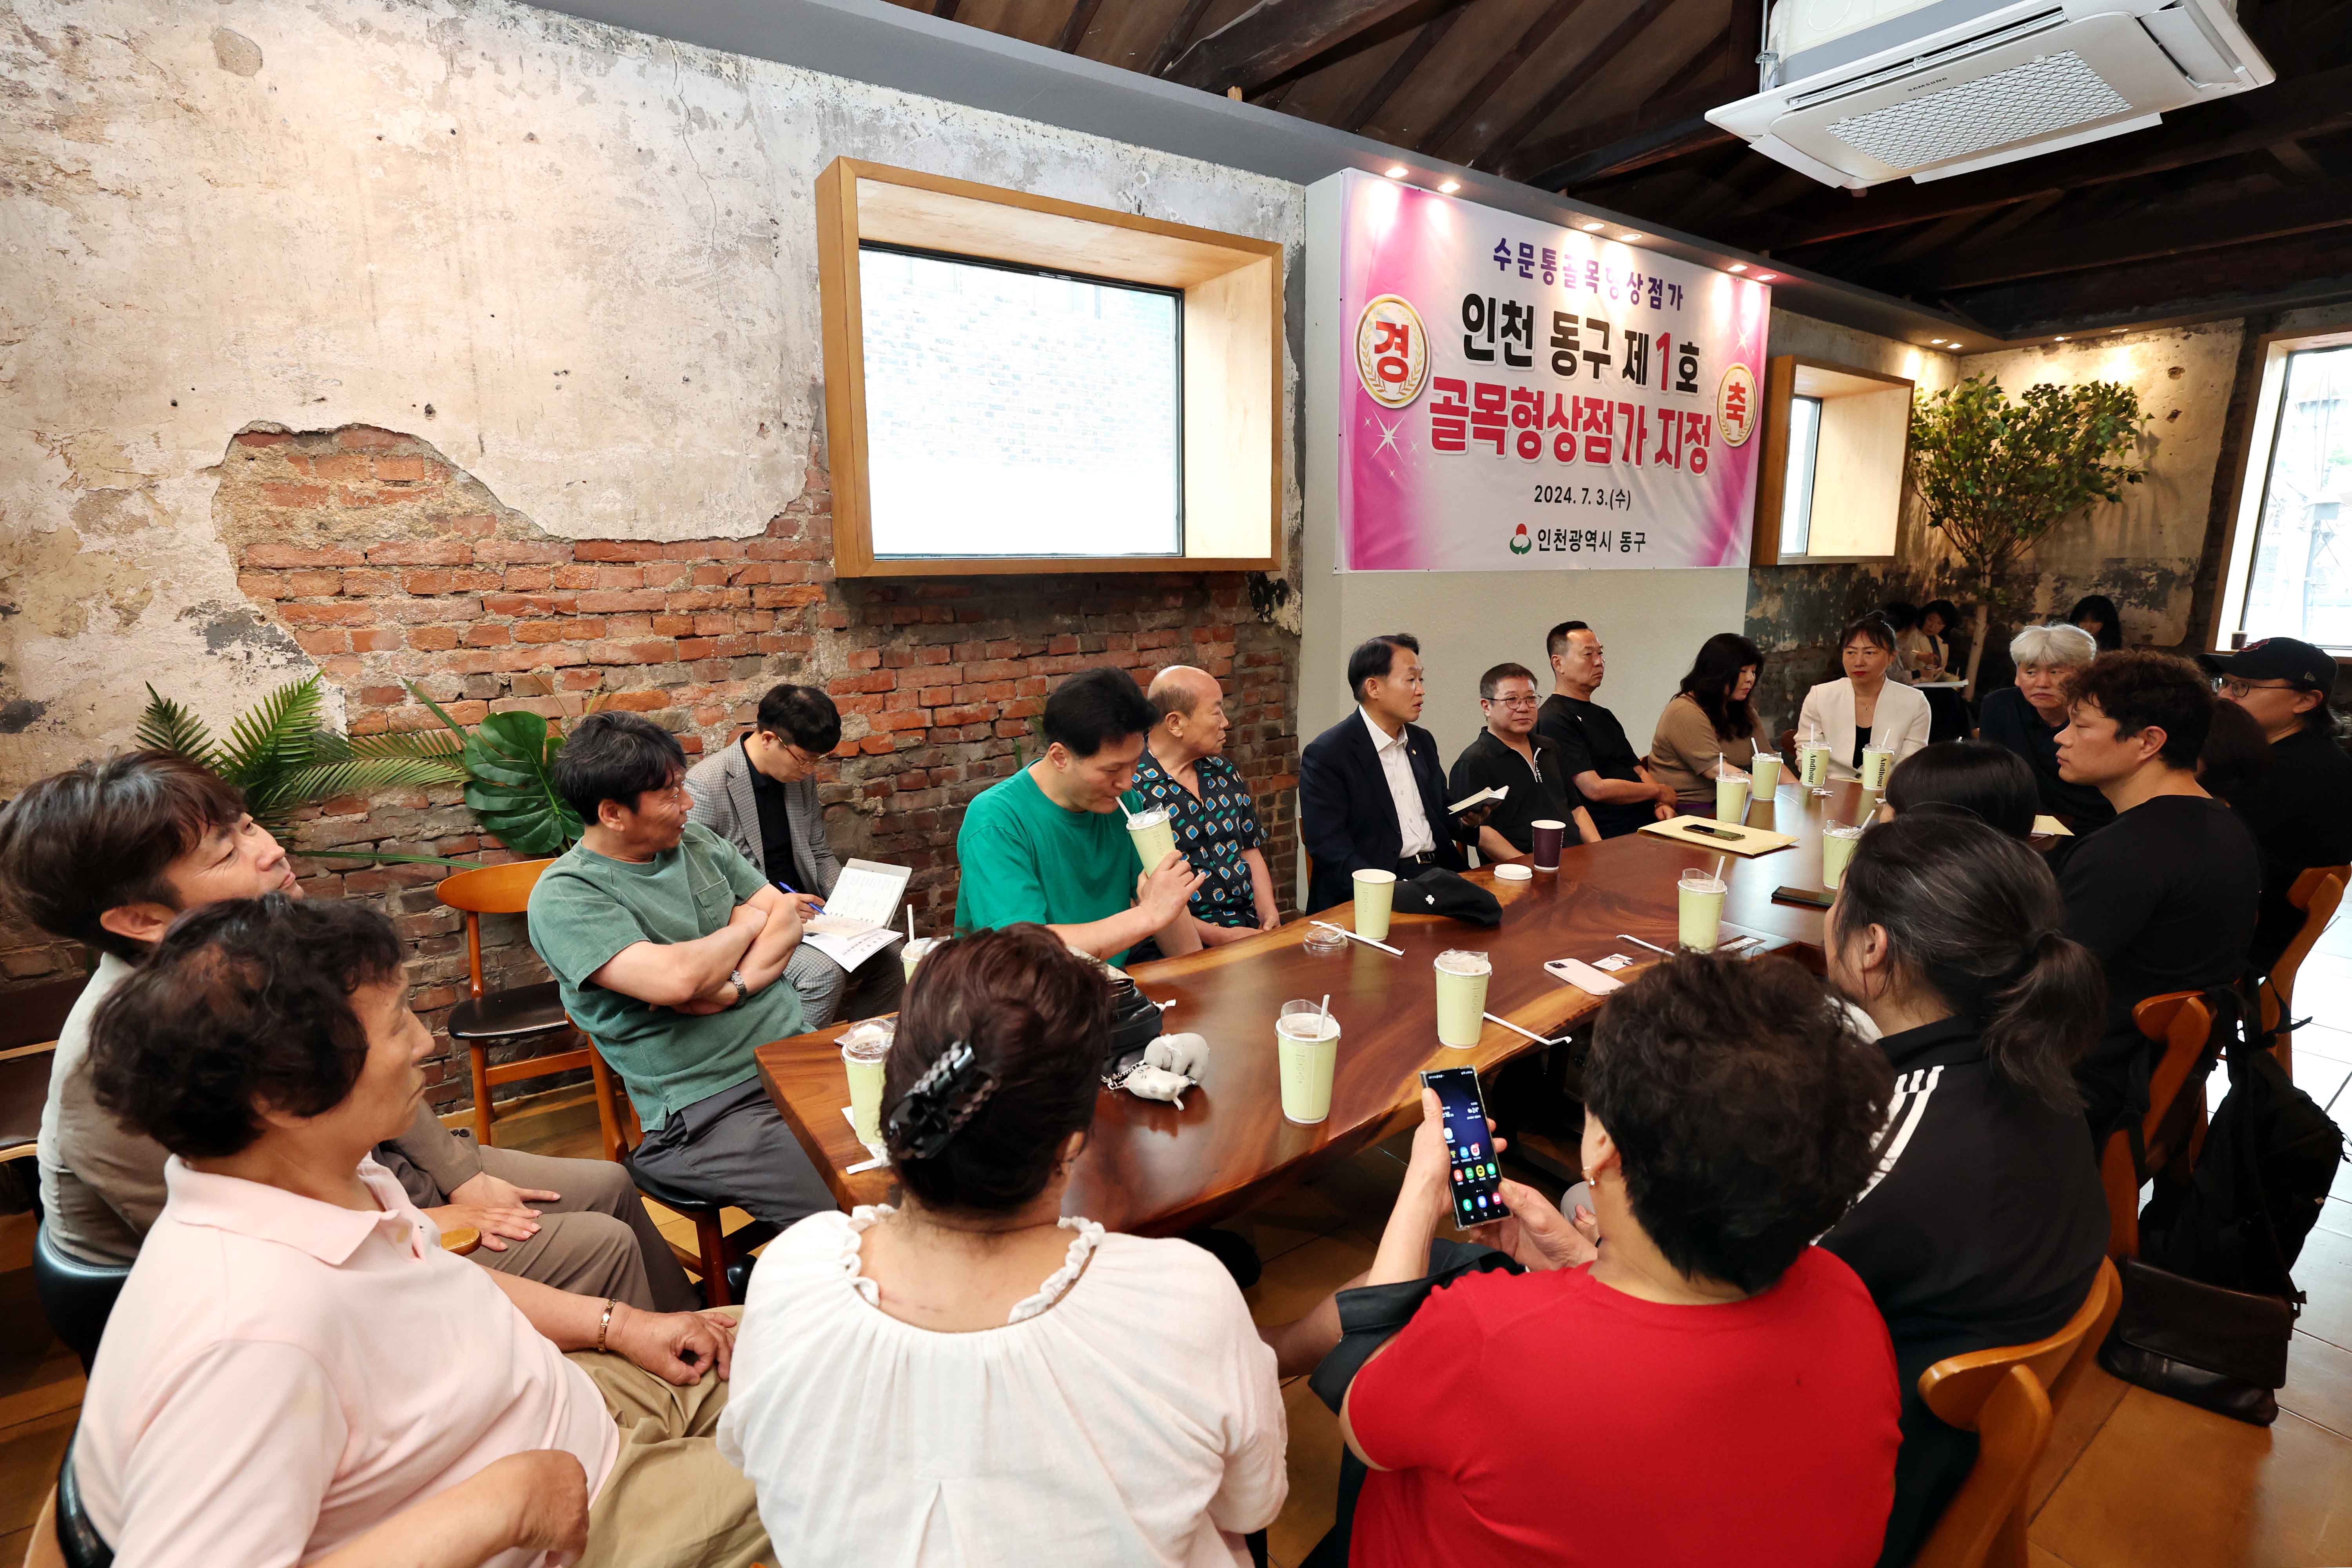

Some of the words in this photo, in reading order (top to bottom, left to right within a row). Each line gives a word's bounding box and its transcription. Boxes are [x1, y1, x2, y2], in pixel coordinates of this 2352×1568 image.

[1908, 77, 1947, 91] SAMSUNG
[1493, 238, 1683, 311] 수문통골목형상점가
[1374, 321, 1409, 383] 경
[1462, 293, 1534, 367] 인천
[1550, 311, 1611, 379] 동구
[1622, 330, 1700, 394] 제1호
[1726, 382, 1746, 428] 축
[1430, 377, 1647, 466] 골목형상점가
[1654, 408, 1711, 474] 지정
[1534, 485, 1576, 504] 2024.
[1582, 487, 1591, 505] 7.
[1537, 528, 1612, 552] 인천광역시
[1620, 531, 1646, 553] 동구
[1808, 753, 1817, 784] Andhour
[1877, 757, 1887, 788] Andhour
